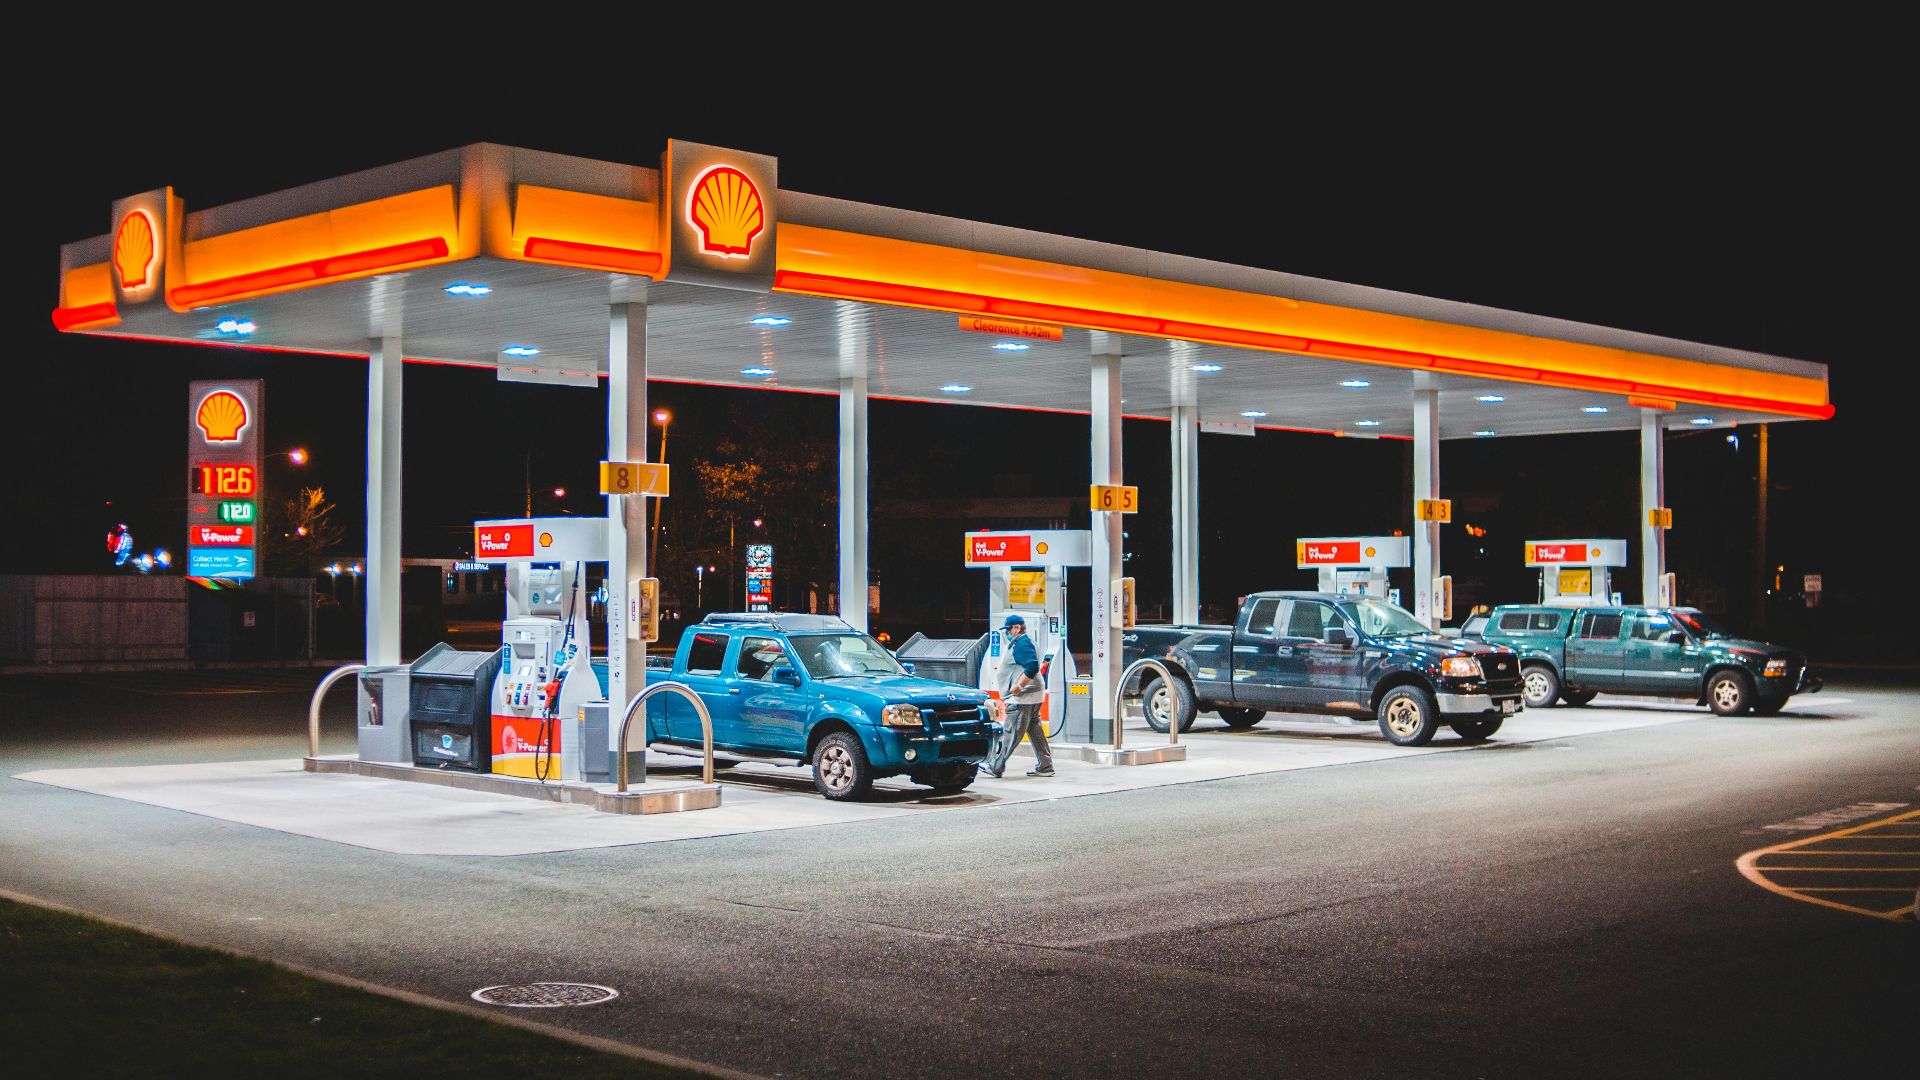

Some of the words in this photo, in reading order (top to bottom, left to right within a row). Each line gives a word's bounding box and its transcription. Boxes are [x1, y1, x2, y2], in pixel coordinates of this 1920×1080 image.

[973, 319, 1020, 335] Clearance
[1022, 325, 1050, 339] 4.42m
[616, 467, 630, 490] 8
[647, 469, 660, 490] 7
[1103, 489, 1112, 508] 6
[1123, 490, 1132, 508] 5
[1426, 503, 1434, 518] 4
[1440, 503, 1447, 519] 3
[202, 533, 241, 543] V-Power
[481, 541, 509, 551] V-Power
[975, 548, 1005, 557] V-Power
[192, 555, 213, 563] Collect
[517, 741, 549, 752] V-Power
